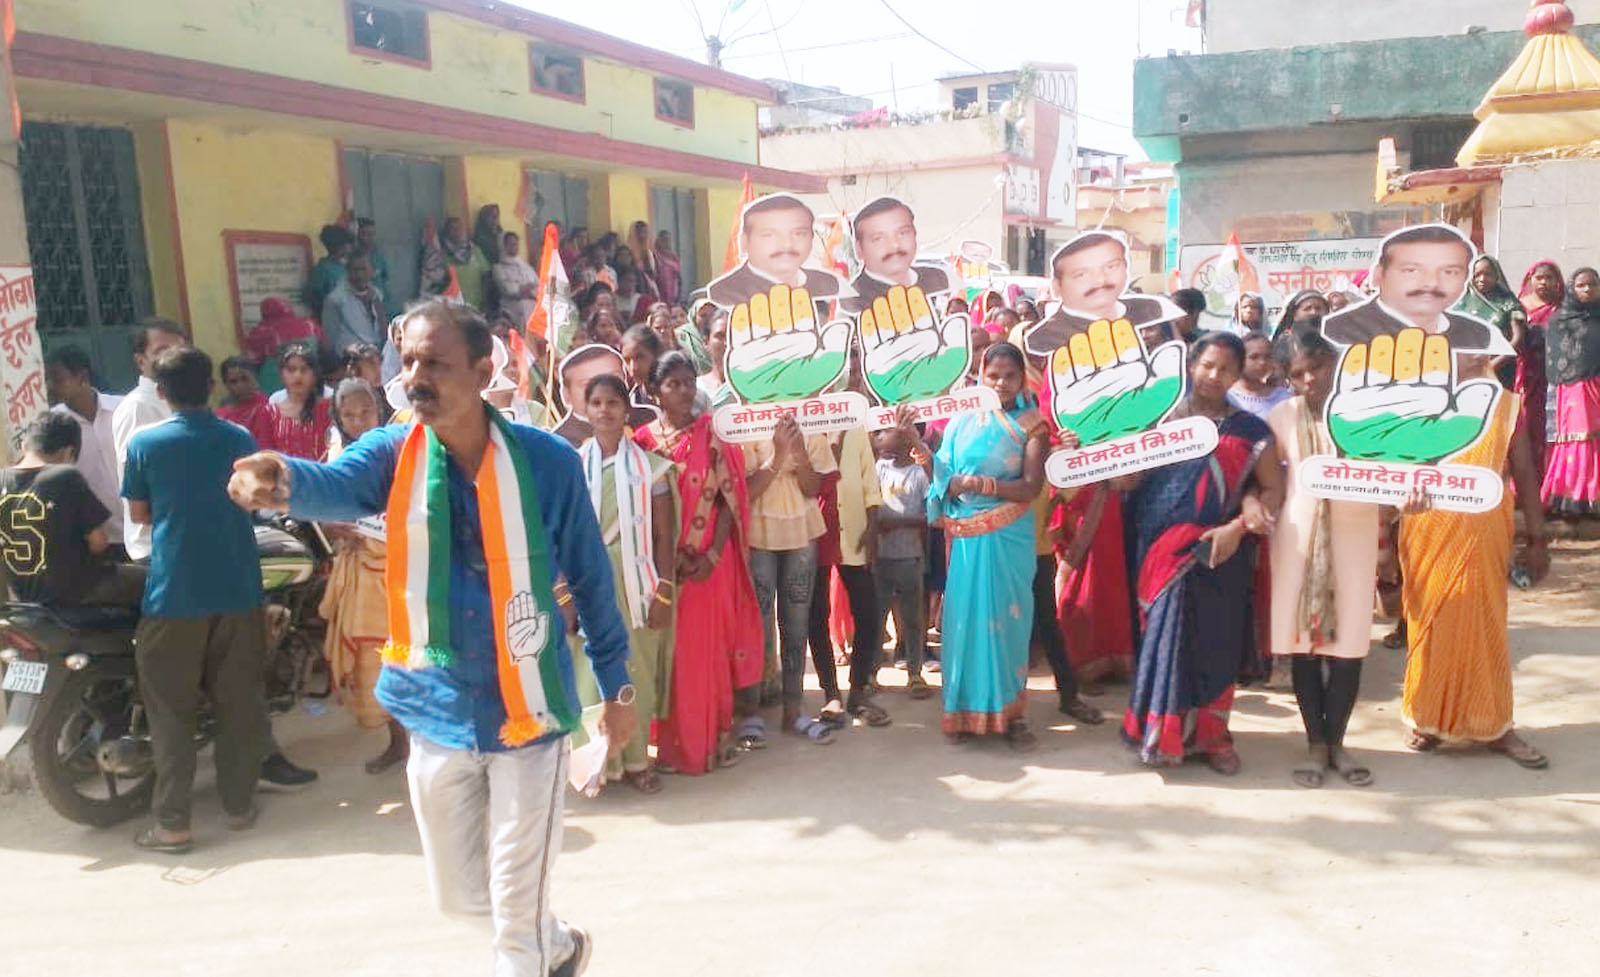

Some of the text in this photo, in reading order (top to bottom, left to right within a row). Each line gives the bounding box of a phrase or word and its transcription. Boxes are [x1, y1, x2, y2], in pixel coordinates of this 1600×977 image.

[802, 400, 849, 417] मिश्रा
[1065, 427, 1193, 470] सोमदेव मिश्रा
[1322, 462, 1477, 491] सोमदेव मिश्रा
[0, 492, 45, 575] S
